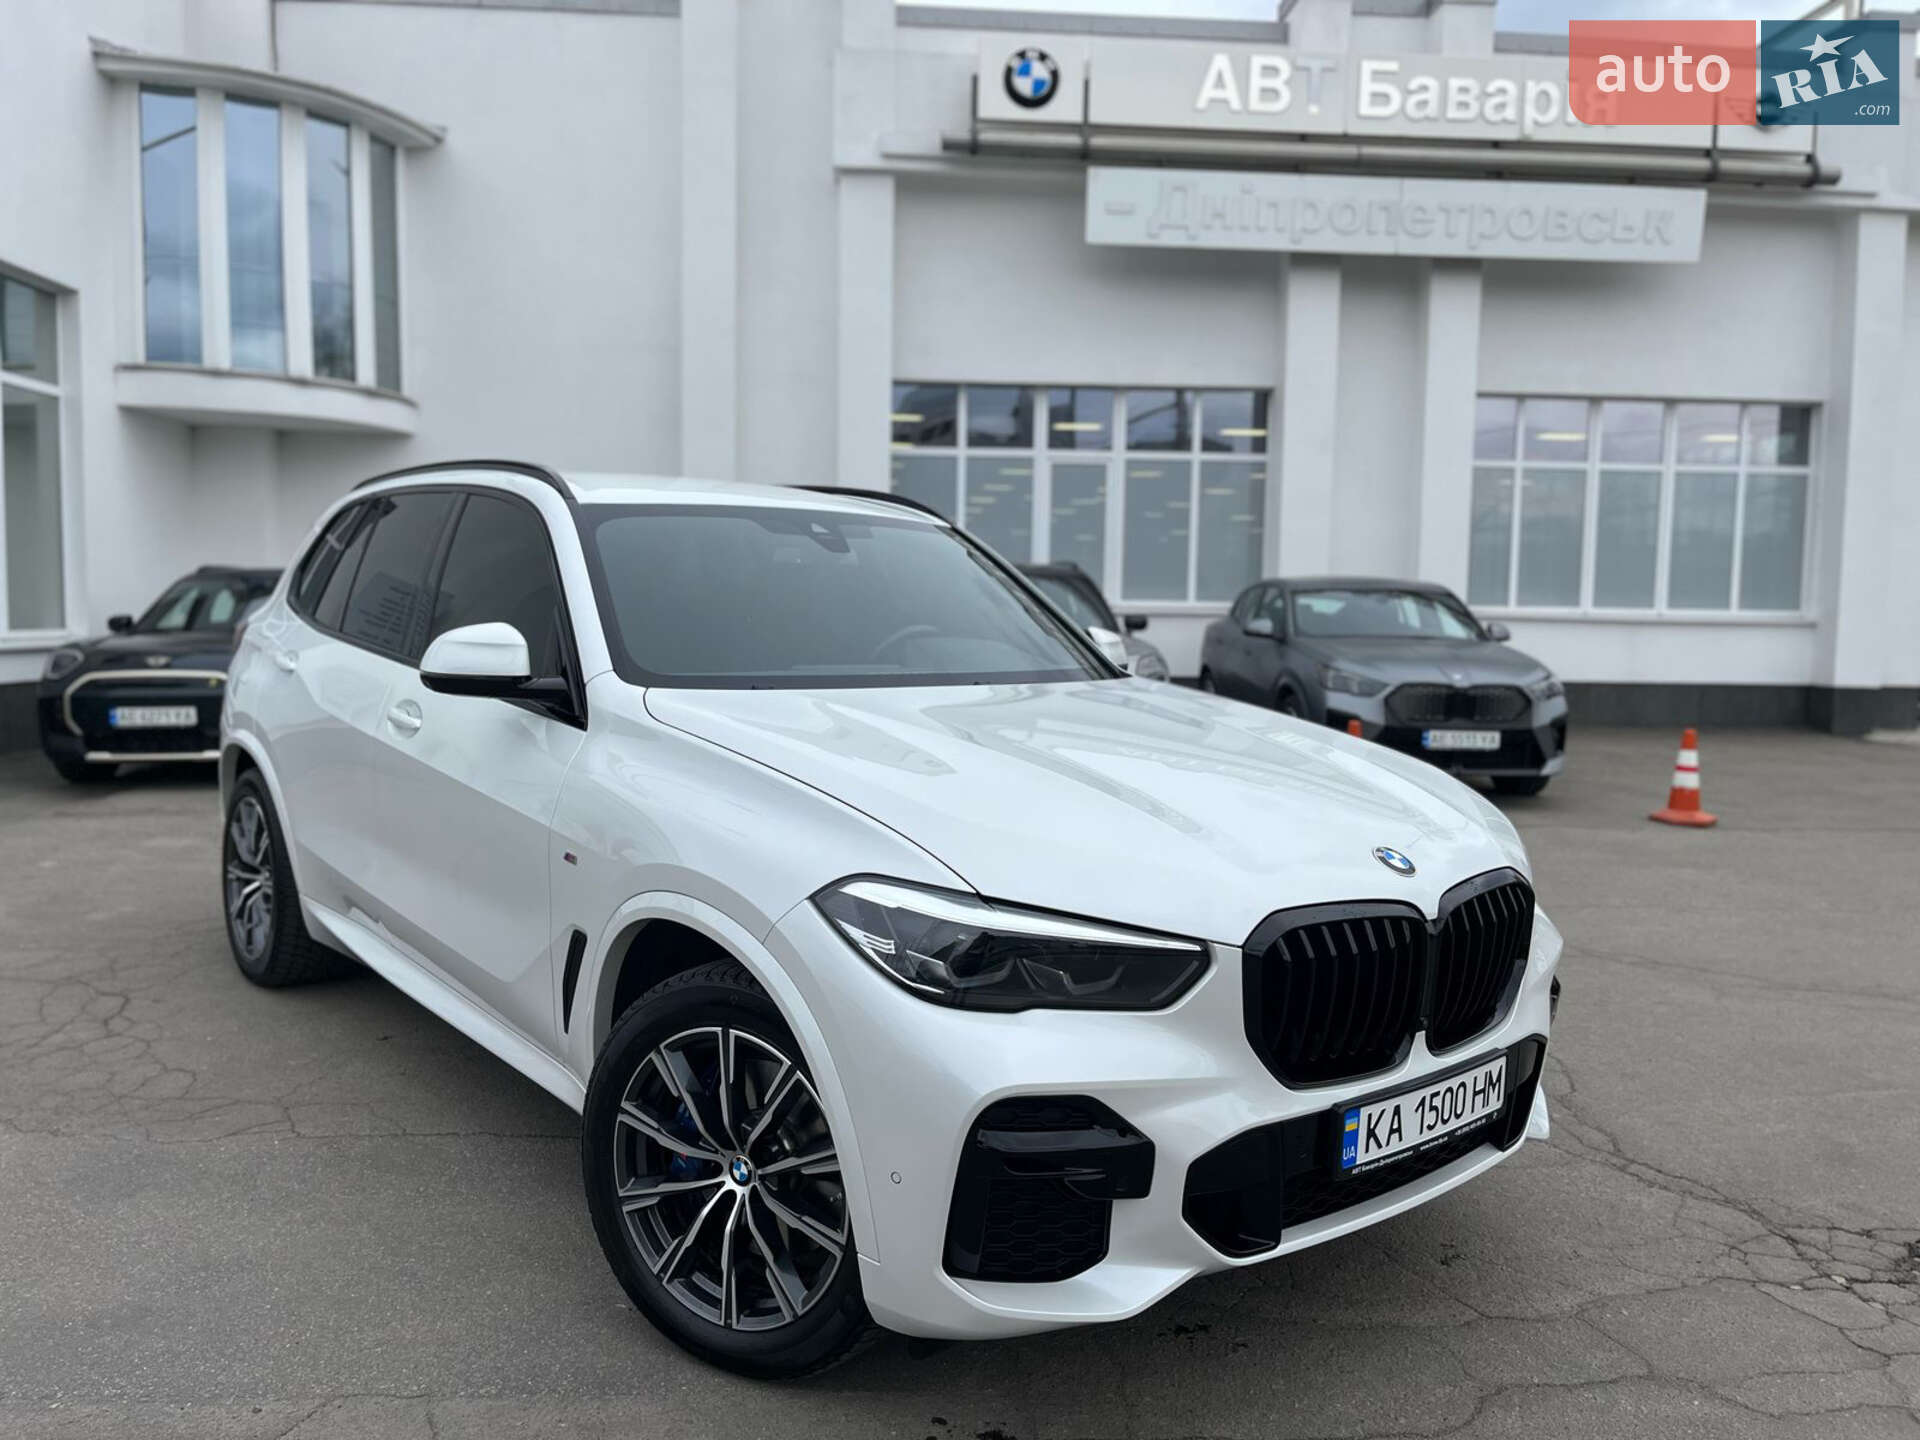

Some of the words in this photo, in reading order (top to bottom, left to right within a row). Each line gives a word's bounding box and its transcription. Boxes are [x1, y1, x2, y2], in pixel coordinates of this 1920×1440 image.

[1146, 179, 1676, 250] Дніпропетровськ
[1364, 1103, 1404, 1154] KA
[1415, 1081, 1468, 1136] 1500
[1471, 1064, 1503, 1114] HM
[1342, 1145, 1356, 1161] UA
